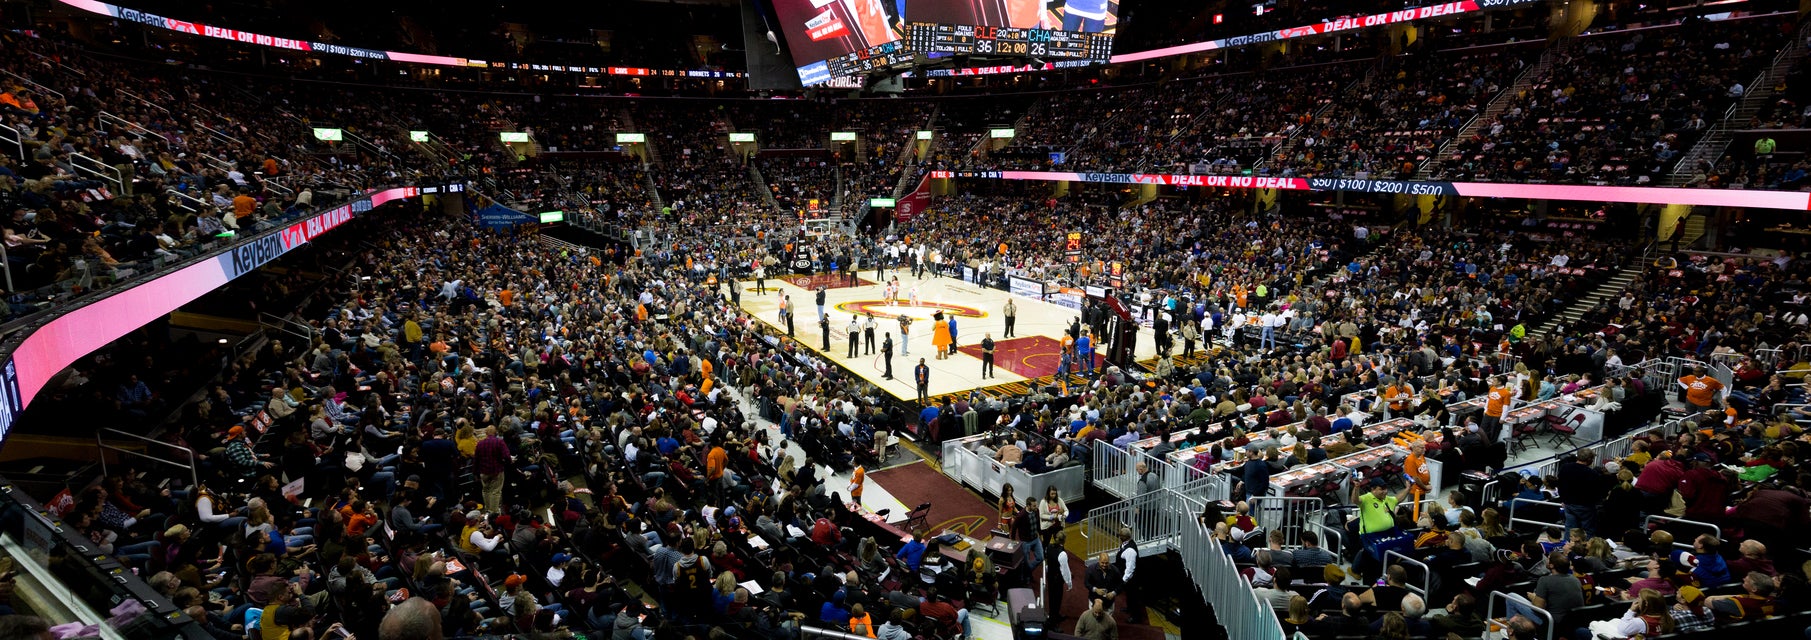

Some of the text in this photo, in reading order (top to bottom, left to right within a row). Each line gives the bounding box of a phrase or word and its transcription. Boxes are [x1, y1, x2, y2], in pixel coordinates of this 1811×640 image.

[118, 7, 166, 28] KeyBank
[1323, 2, 1465, 32] DEAL OR NO DEAL
[204, 25, 302, 50] DEAL OR NO DEAL
[974, 26, 998, 39] CLE
[997, 29, 1007, 38] 2Q
[1029, 29, 1050, 42] CHA
[1224, 31, 1278, 47] KeyBank
[313, 42, 325, 51] $50
[330, 45, 345, 55] $100
[350, 48, 365, 57] $200
[977, 40, 992, 52] 36
[997, 42, 1027, 53] 12:00
[1031, 43, 1045, 55] 26
[858, 47, 871, 60] CLE
[887, 53, 897, 64] 26
[978, 67, 998, 75] DEAL
[1085, 173, 1131, 183] KeyBank
[1171, 175, 1296, 189] DEAL OR NO DEAL
[1313, 179, 1331, 187] $50
[1339, 179, 1365, 190] $100
[1374, 181, 1401, 193] $200
[1411, 185, 1442, 195] $500
[307, 215, 323, 239] DEAL
[339, 204, 350, 223] DEAL
[1067, 240, 1079, 250] 24
[232, 231, 283, 276] KeyBank
